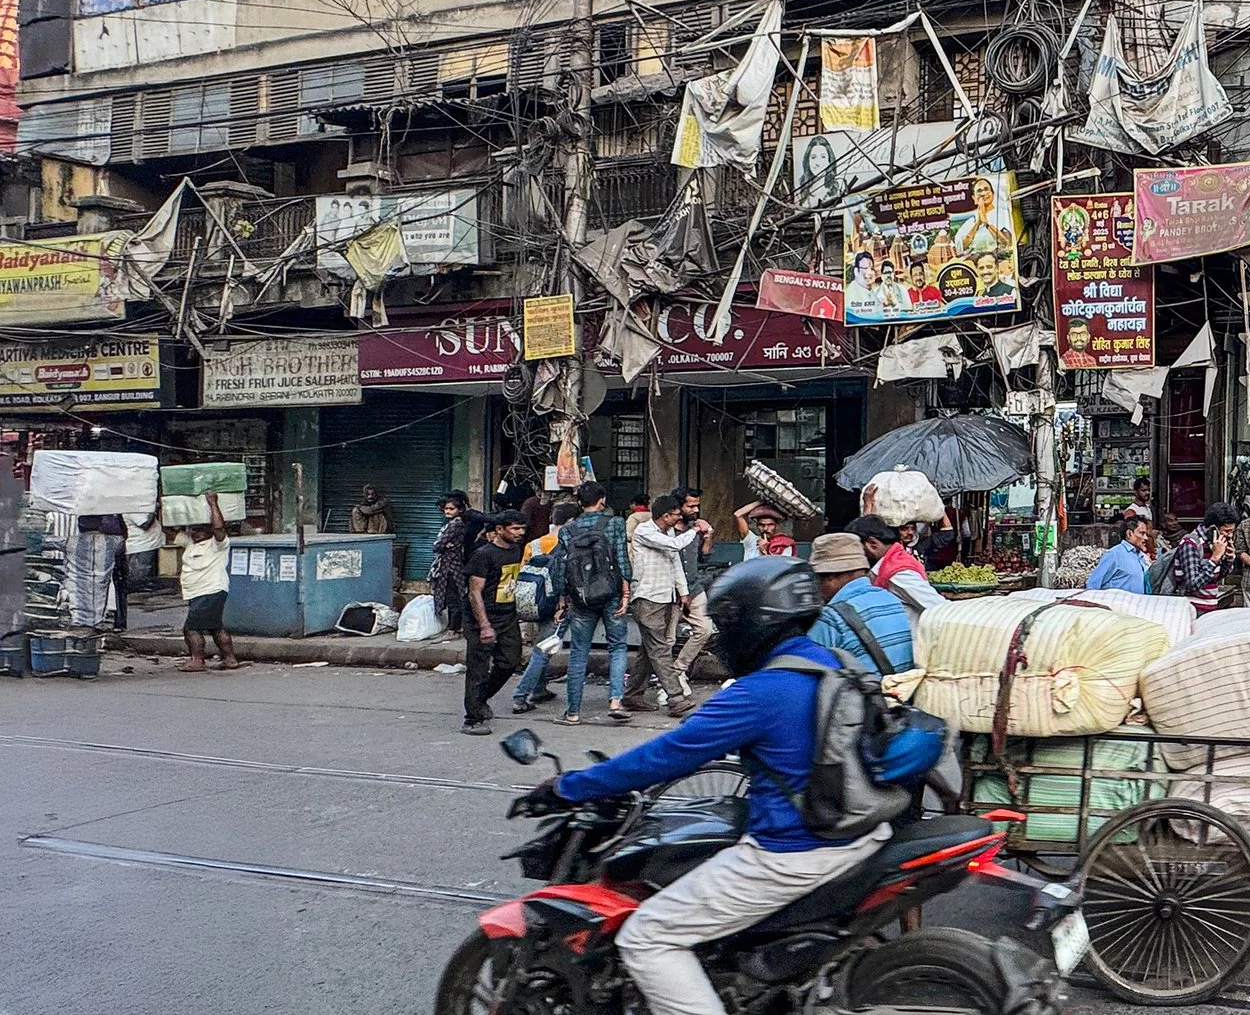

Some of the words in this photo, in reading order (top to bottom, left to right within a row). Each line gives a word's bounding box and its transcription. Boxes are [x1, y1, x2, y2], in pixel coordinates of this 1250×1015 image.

[1166, 192, 1236, 216] Tarak
[1091, 211, 1098, 220] 4
[1103, 210, 1109, 219] 6
[1159, 227, 1193, 238] PANDEY
[1102, 242, 1108, 251] 9
[774, 274, 811, 287] BENGAL'S
[811, 279, 830, 290] NO.1
[830, 283, 845, 292] SA
[1083, 281, 1098, 299] श्री
[944, 286, 974, 297] 30-4-2025
[1107, 317, 1147, 332] महायज्ञ
[101, 340, 150, 357] CENTRE
[763, 342, 789, 360] সানি
[1092, 336, 1111, 351] रोहित
[1113, 338, 1134, 353] कुमार
[468, 364, 483, 374] 114,
[668, 354, 700, 364] OLKATA
[706, 352, 734, 362] 700007
[215, 379, 245, 390] FRESH
[249, 377, 276, 388] FRUIT
[278, 375, 303, 388] JUCE
[120, 391, 154, 400] BUILDING
